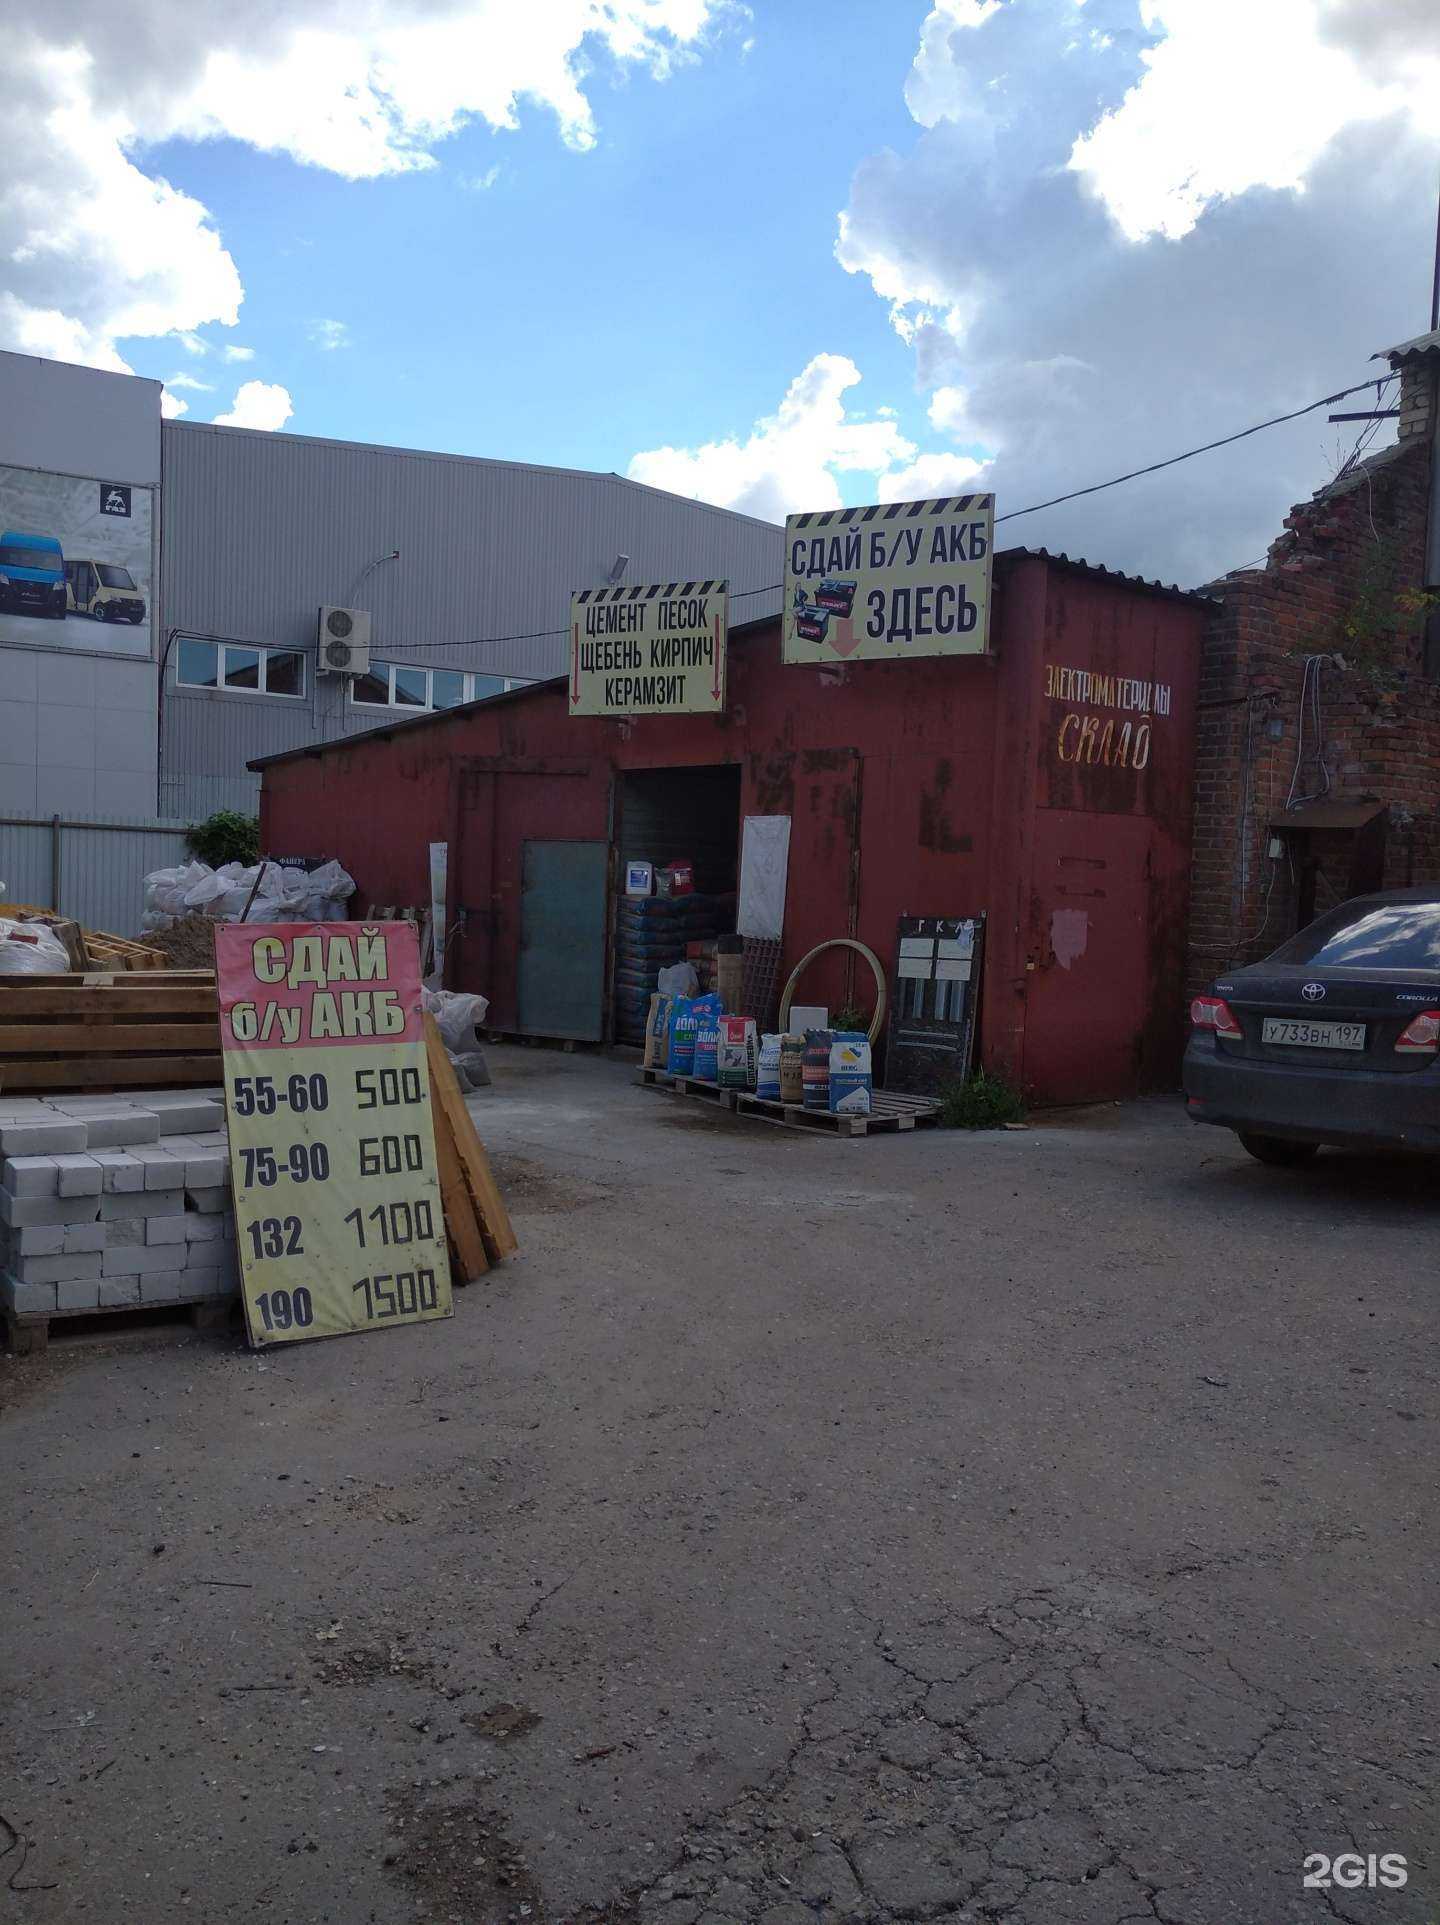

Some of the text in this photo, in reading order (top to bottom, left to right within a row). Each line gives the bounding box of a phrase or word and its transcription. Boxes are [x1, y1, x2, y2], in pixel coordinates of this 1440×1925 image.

[791, 522, 988, 578] СДАЙ Б/У АКБ
[586, 599, 708, 638] ЦЕМЕНТ ПЕСОК
[866, 584, 979, 644] ЗДЕСЬ
[580, 636, 714, 674] ЩЕБЕНЬ КИРПИЧ
[604, 674, 687, 707] КЕРАМЗИТ
[251, 927, 390, 990] СДАЙ
[231, 990, 406, 1044] б/у АКБ
[234, 1067, 421, 1117] 55-60 500
[238, 1134, 423, 1188] 75-90 600
[247, 1200, 434, 1260] 132 1100
[254, 1269, 439, 1332] 190 1500
